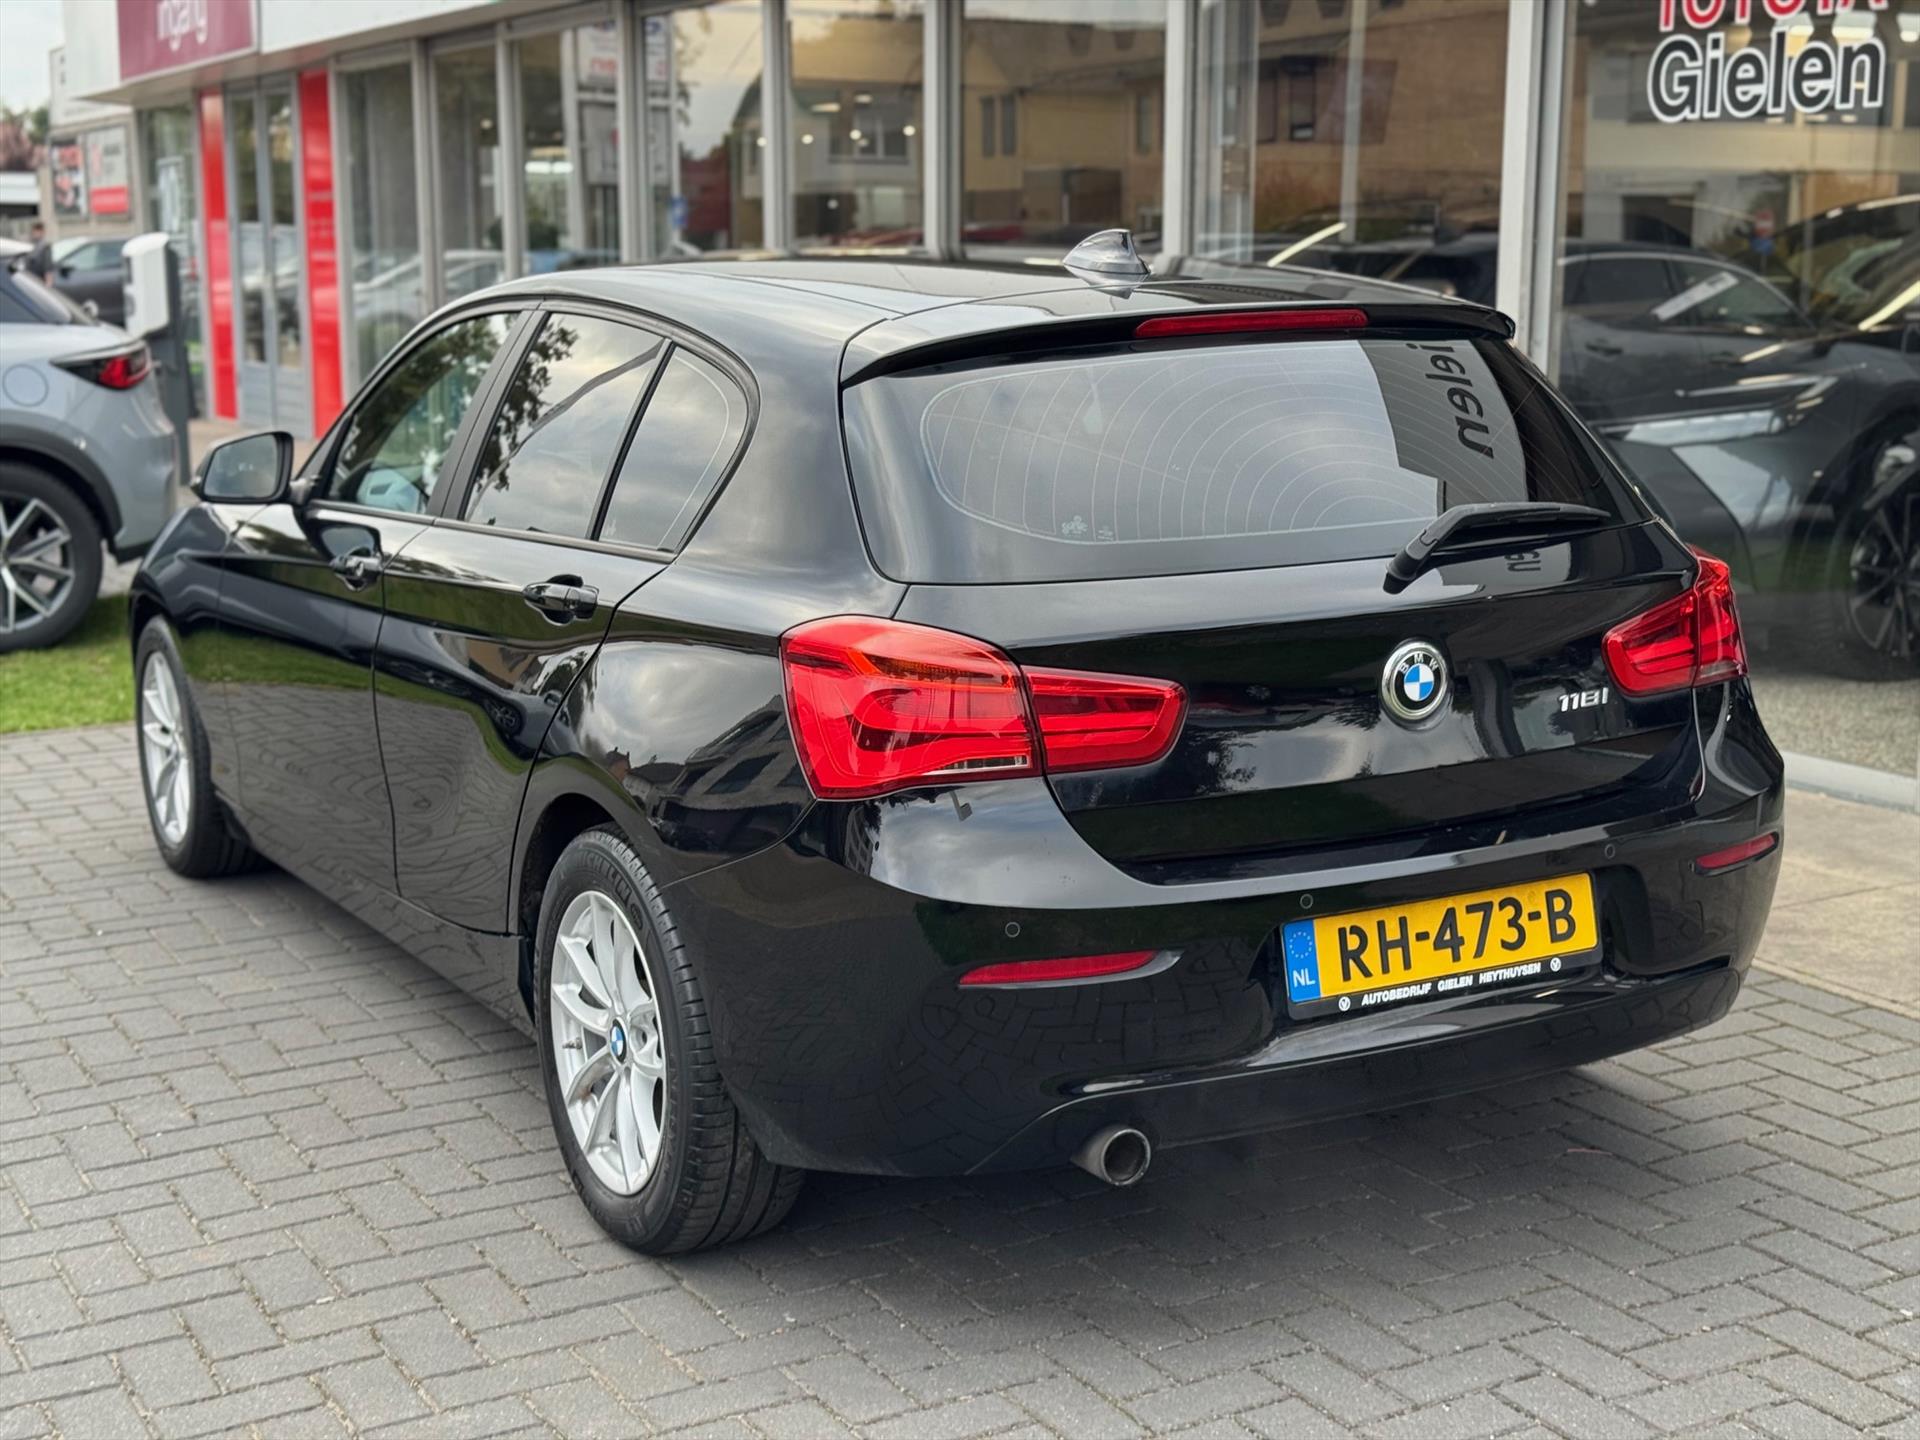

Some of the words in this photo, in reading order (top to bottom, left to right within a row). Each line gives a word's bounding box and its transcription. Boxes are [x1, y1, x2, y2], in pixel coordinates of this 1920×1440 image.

[1647, 25, 1886, 123] Gielen
[1337, 888, 1577, 982] RH-473-B
[1292, 967, 1316, 988] NL
[1361, 984, 1432, 1006] AUTOBEDRIJF
[1437, 975, 1473, 992] GIELEN
[1479, 963, 1541, 984] HEYTHUYSEN
